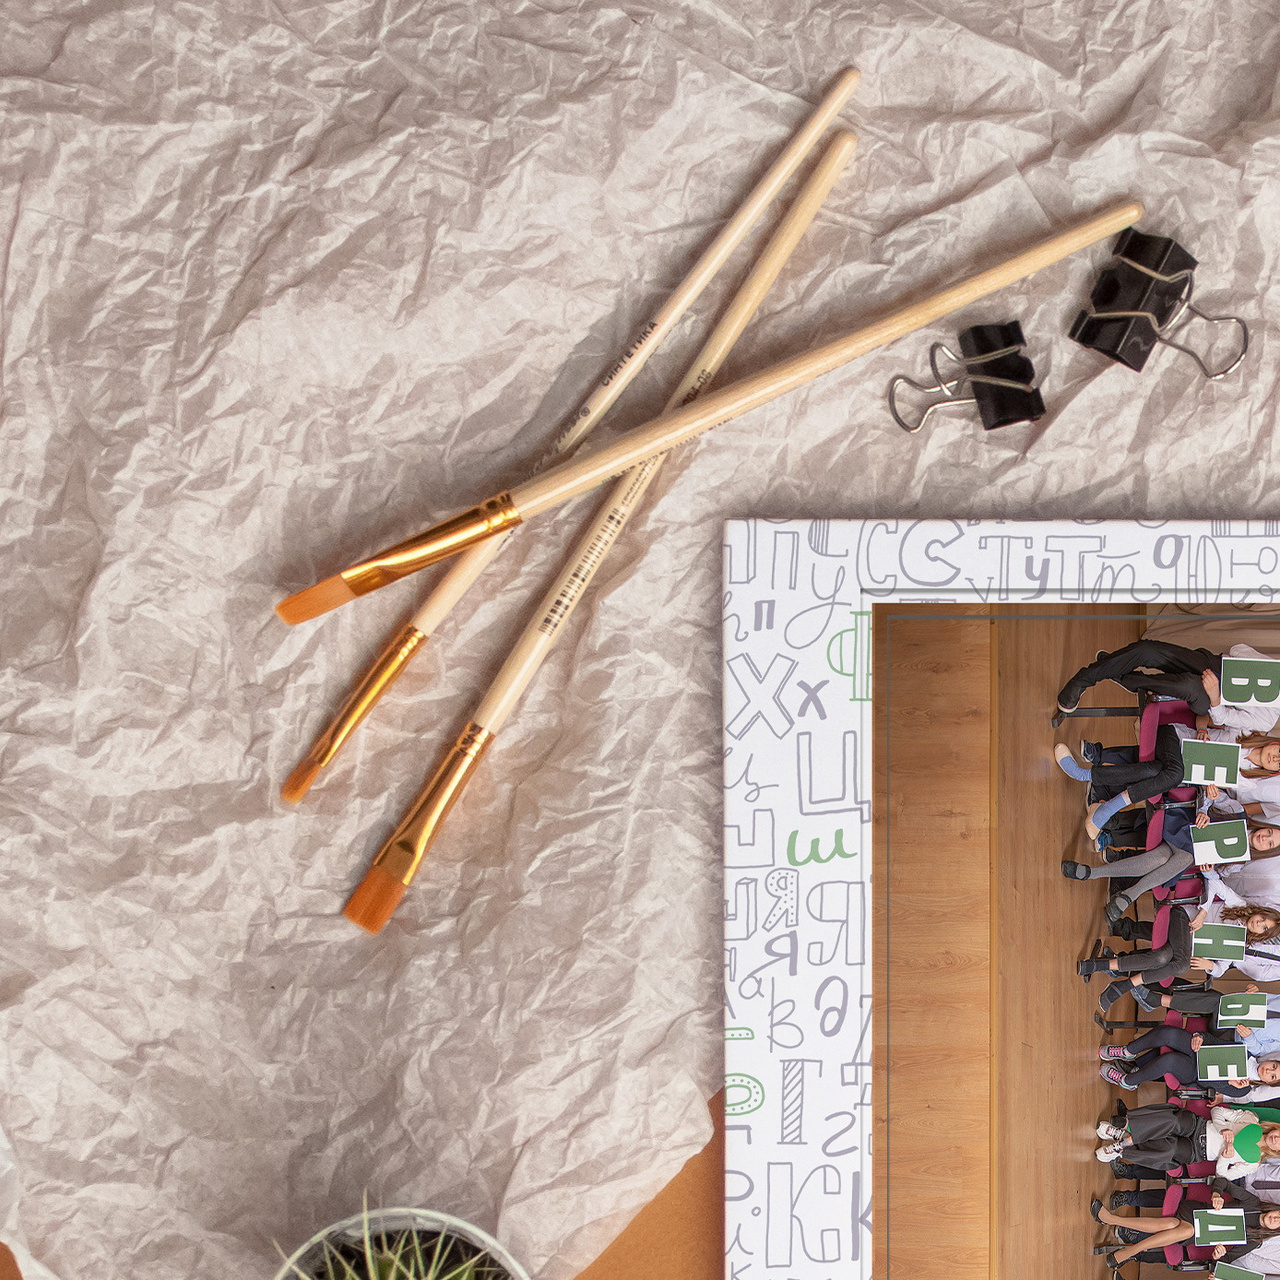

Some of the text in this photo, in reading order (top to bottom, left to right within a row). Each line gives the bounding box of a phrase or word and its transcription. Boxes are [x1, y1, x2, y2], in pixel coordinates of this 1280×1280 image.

[1183, 741, 1239, 783] Е
[1192, 821, 1247, 858] Р
[1193, 924, 1245, 959] Н
[1219, 994, 1266, 1027] Ы
[1198, 1046, 1246, 1079] Е
[1195, 1211, 1245, 1245] Д
